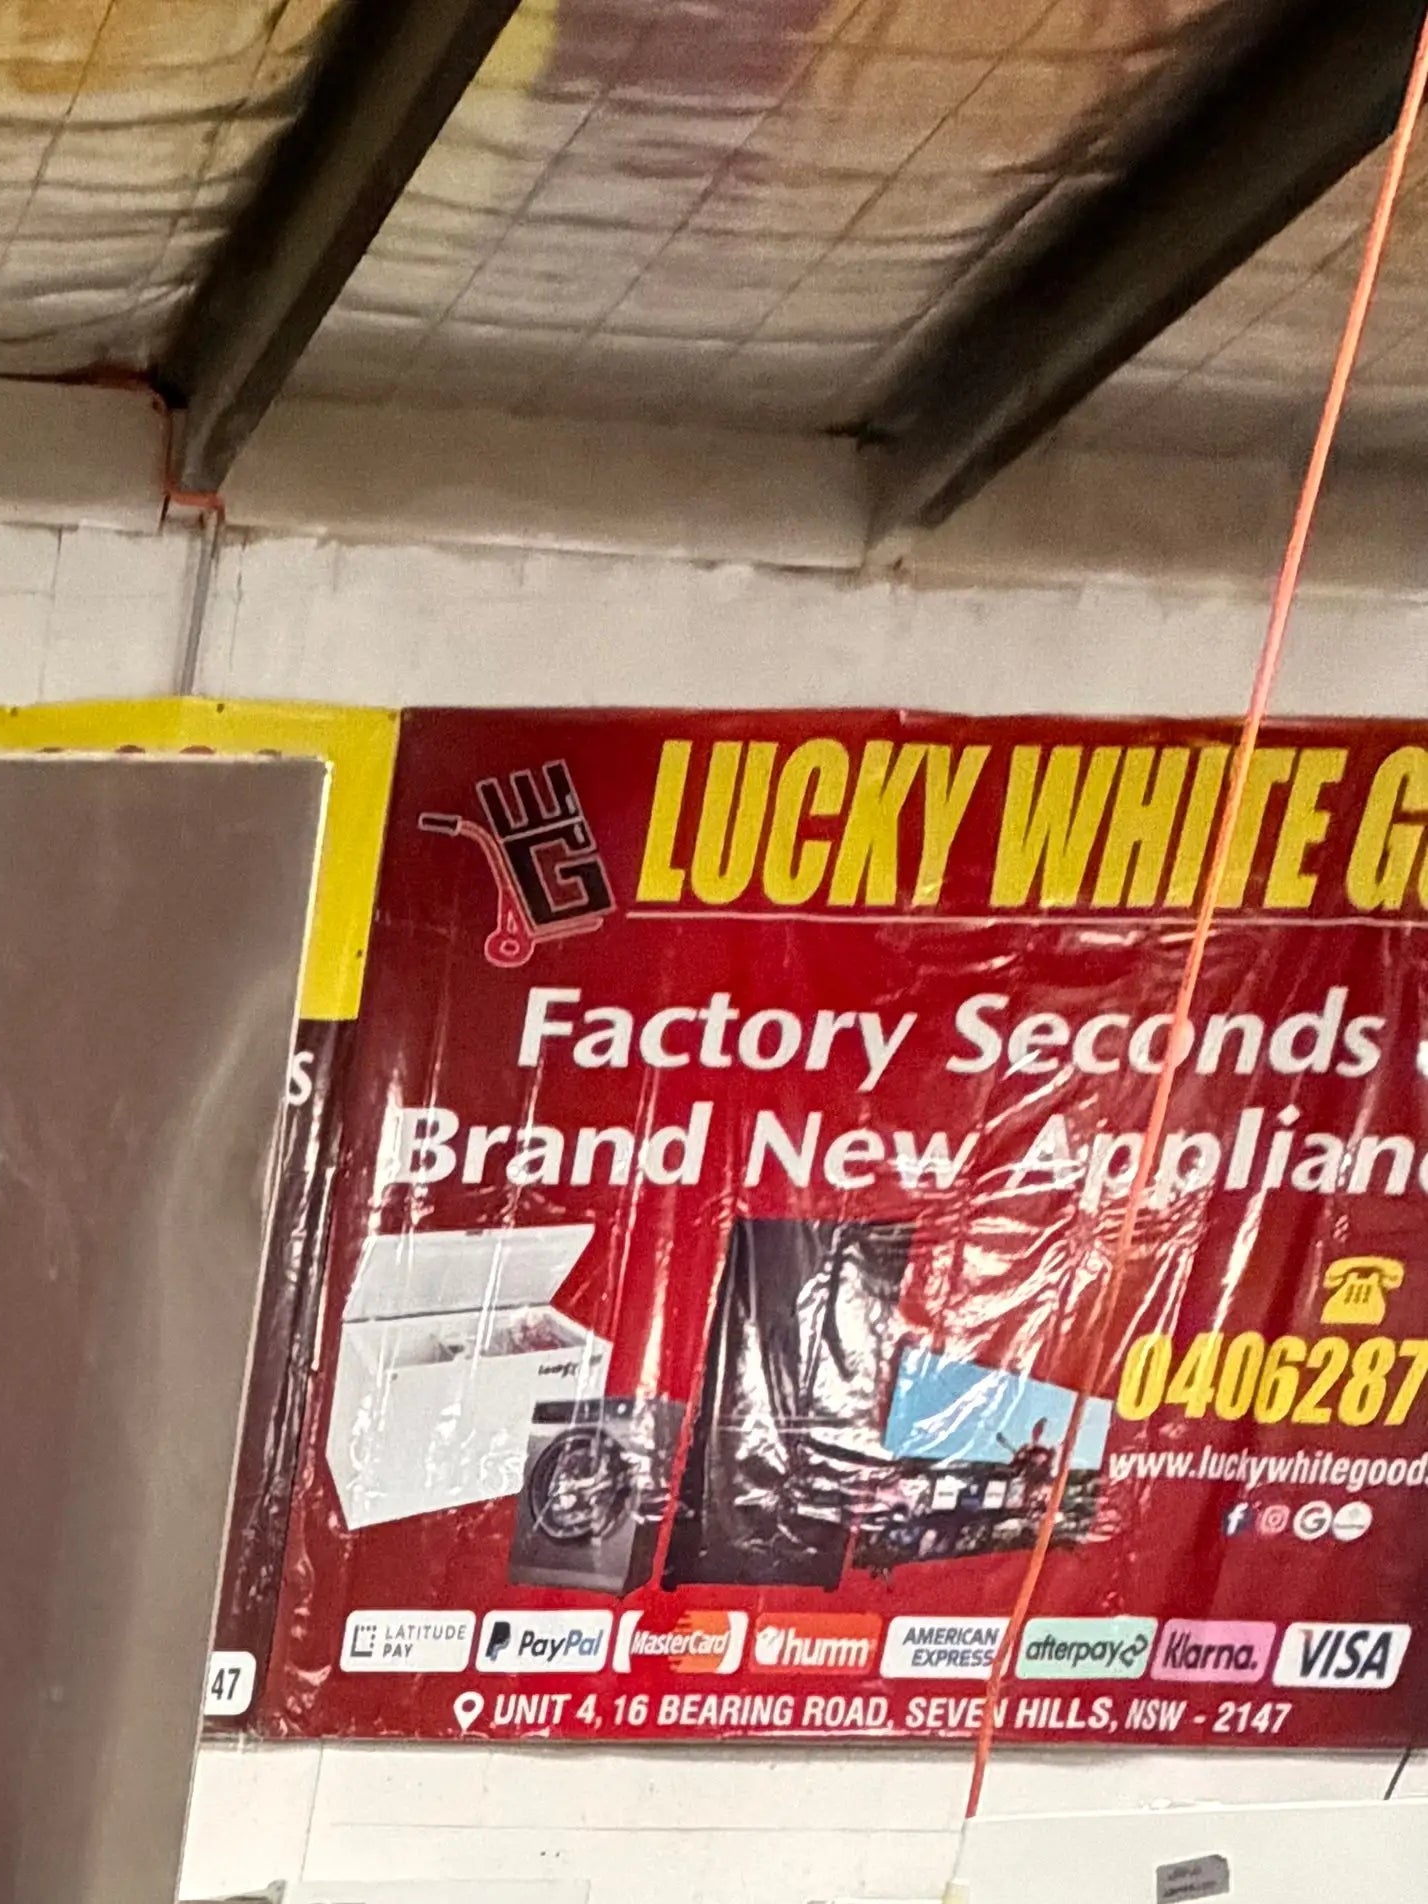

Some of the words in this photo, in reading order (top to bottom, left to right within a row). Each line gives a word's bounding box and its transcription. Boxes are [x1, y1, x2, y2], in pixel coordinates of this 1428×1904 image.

[635, 739, 992, 907] LUCKY
[988, 744, 1349, 910] WHITE
[1346, 745, 1428, 912] G
[517, 986, 918, 1092] Factory
[945, 985, 1387, 1078] Seconds
[390, 1101, 714, 1187] Brand
[744, 1109, 978, 1191] New
[1010, 1103, 1428, 1210] Applian
[1115, 1329, 1428, 1427] 0406287
[1108, 1445, 1428, 1493] www.luckywhitegood
[382, 1643, 413, 1658] PAY
[384, 1624, 467, 1642] LATITUDE
[518, 1629, 605, 1662] PayPal
[630, 1629, 732, 1656] MasterCard
[783, 1629, 870, 1668] humm
[902, 1626, 1001, 1646] AMERICAN
[1025, 1633, 1122, 1670] afterpay
[910, 1649, 997, 1668] EXPRESS
[1298, 1628, 1394, 1681] VISA
[493, 1693, 572, 1725] UNIT
[576, 1693, 603, 1729] 4,
[613, 1694, 650, 1727] 16
[657, 1693, 794, 1727] BEARING
[801, 1696, 895, 1731] ROAD,
[1014, 1696, 1118, 1732] HILLS,
[1124, 1698, 1188, 1731] NSW
[1212, 1702, 1293, 1734] 2147
